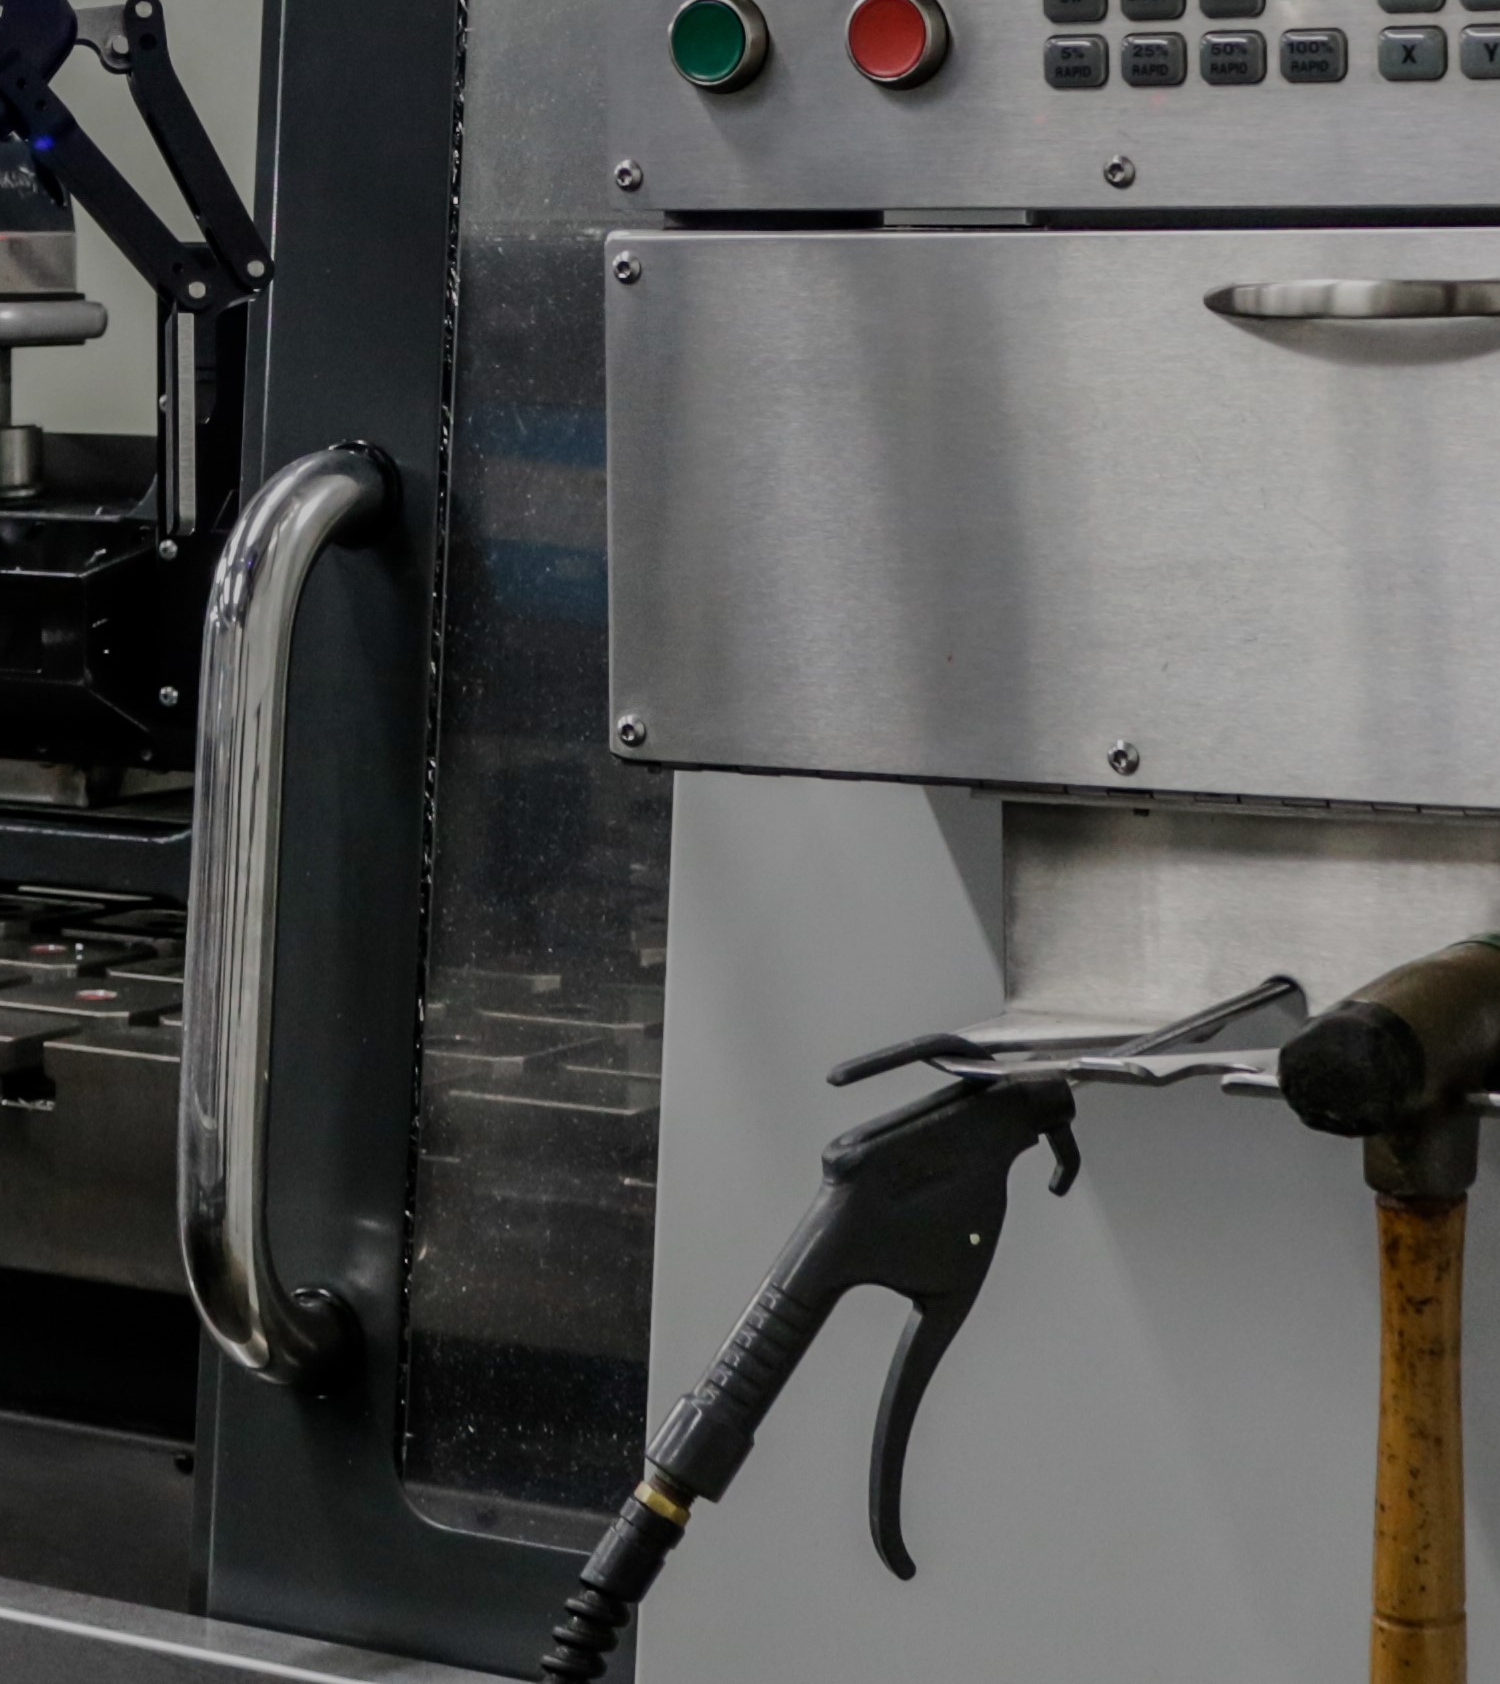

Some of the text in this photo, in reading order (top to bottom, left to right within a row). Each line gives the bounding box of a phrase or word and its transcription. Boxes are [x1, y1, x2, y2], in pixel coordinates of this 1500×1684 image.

[1061, 47, 1085, 59] 5%
[1133, 45, 1168, 58] 25%
[1210, 42, 1247, 56] 50%
[1287, 41, 1333, 54] 100%
[1401, 44, 1417, 64] X
[1484, 43, 1498, 63] Y
[1055, 66, 1091, 78] RAPID
[1132, 64, 1168, 76] RAPID
[1210, 62, 1248, 75] RAPID
[1290, 60, 1329, 73] RAPID
